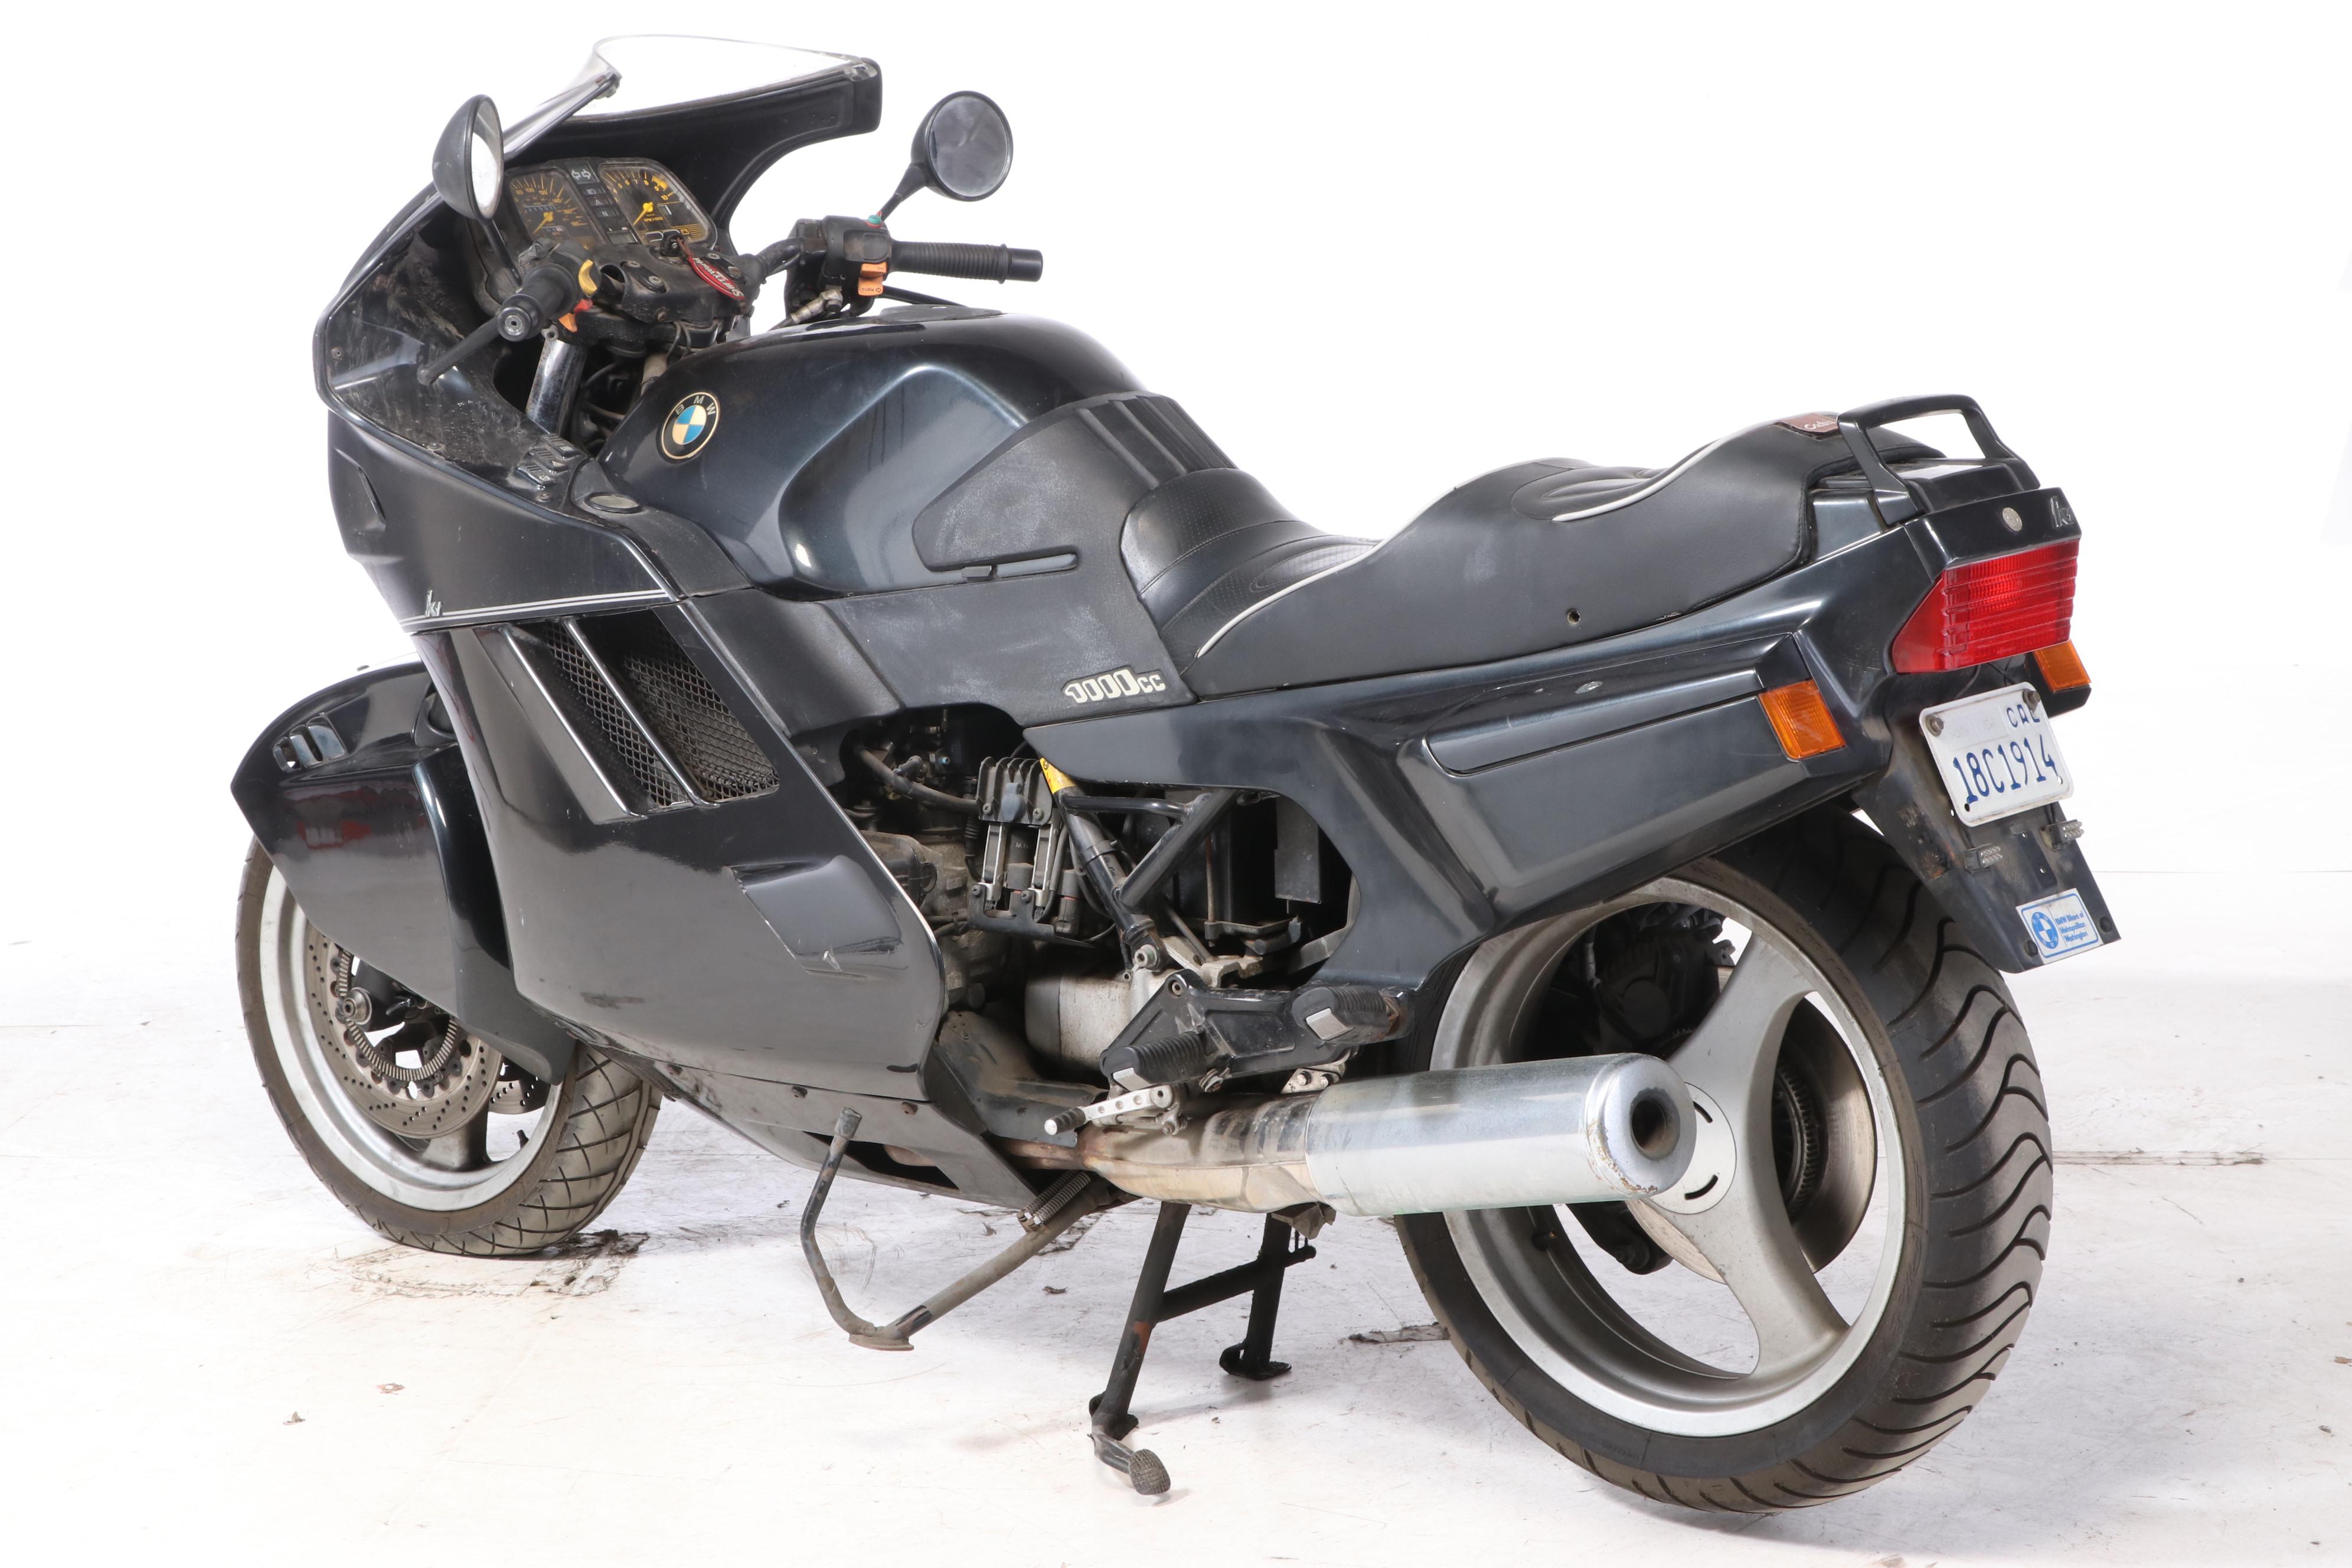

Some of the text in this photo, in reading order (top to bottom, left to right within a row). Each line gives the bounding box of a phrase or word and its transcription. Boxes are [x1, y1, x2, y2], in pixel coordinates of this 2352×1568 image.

[675, 395, 716, 416] BMW
[1064, 668, 1167, 704] 1000cc
[2006, 704, 2041, 728] CAL
[1952, 734, 2059, 805] 18C1914
